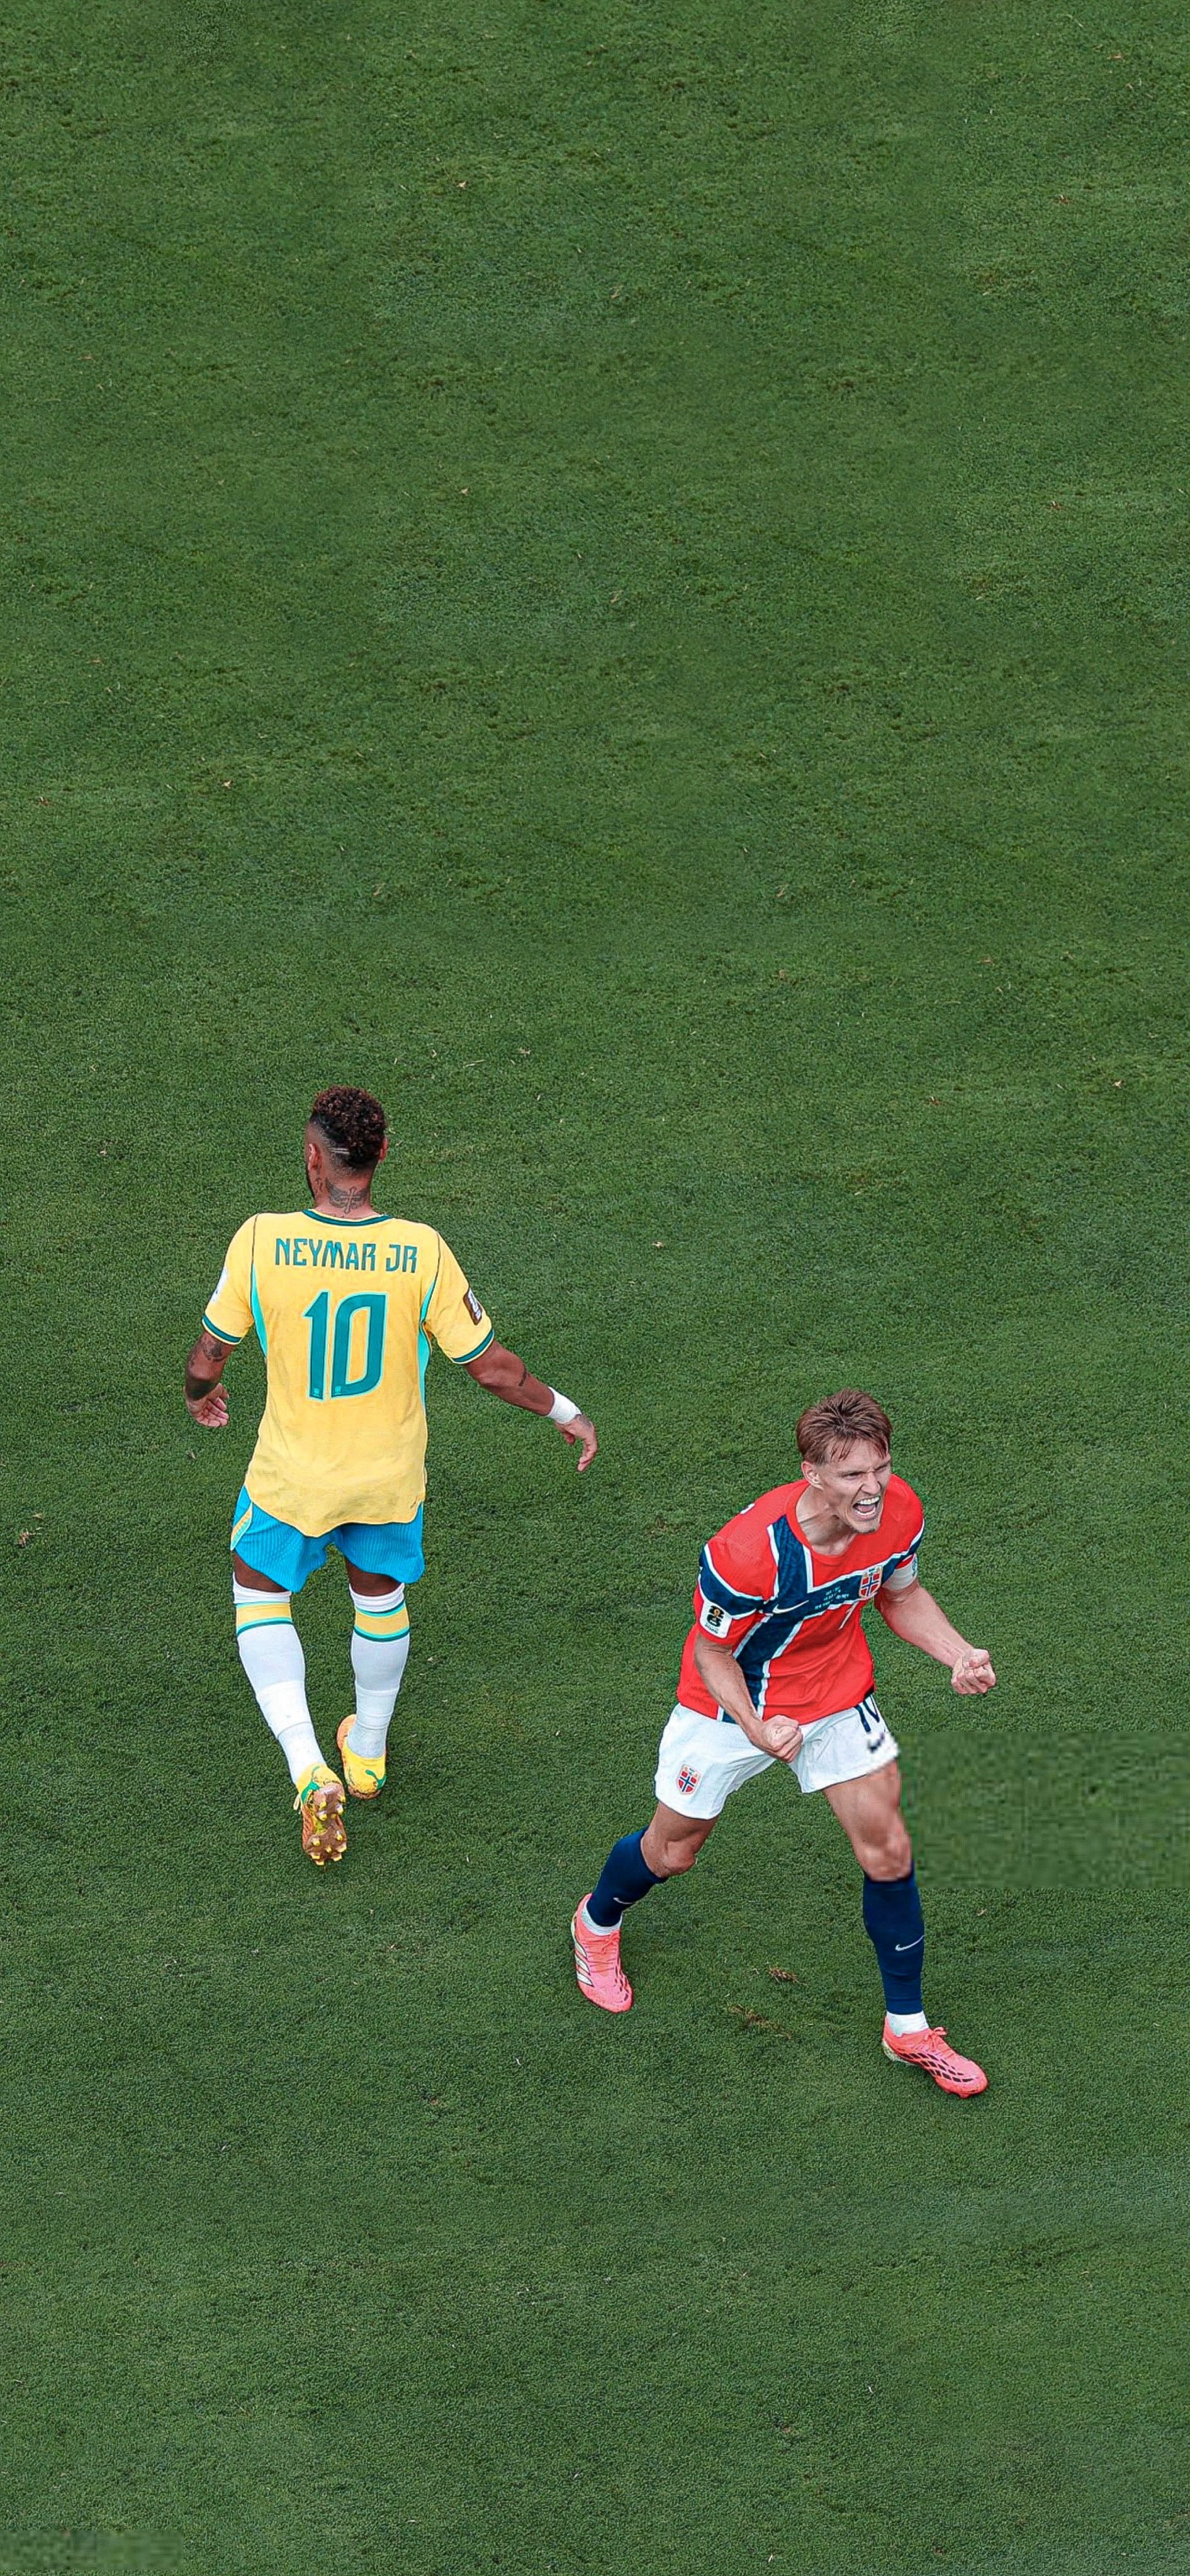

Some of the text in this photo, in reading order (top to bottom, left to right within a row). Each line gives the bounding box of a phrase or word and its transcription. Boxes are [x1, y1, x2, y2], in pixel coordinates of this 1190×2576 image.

[274, 1237, 418, 1273] NEYMAR JR
[303, 1290, 387, 1402] 10
